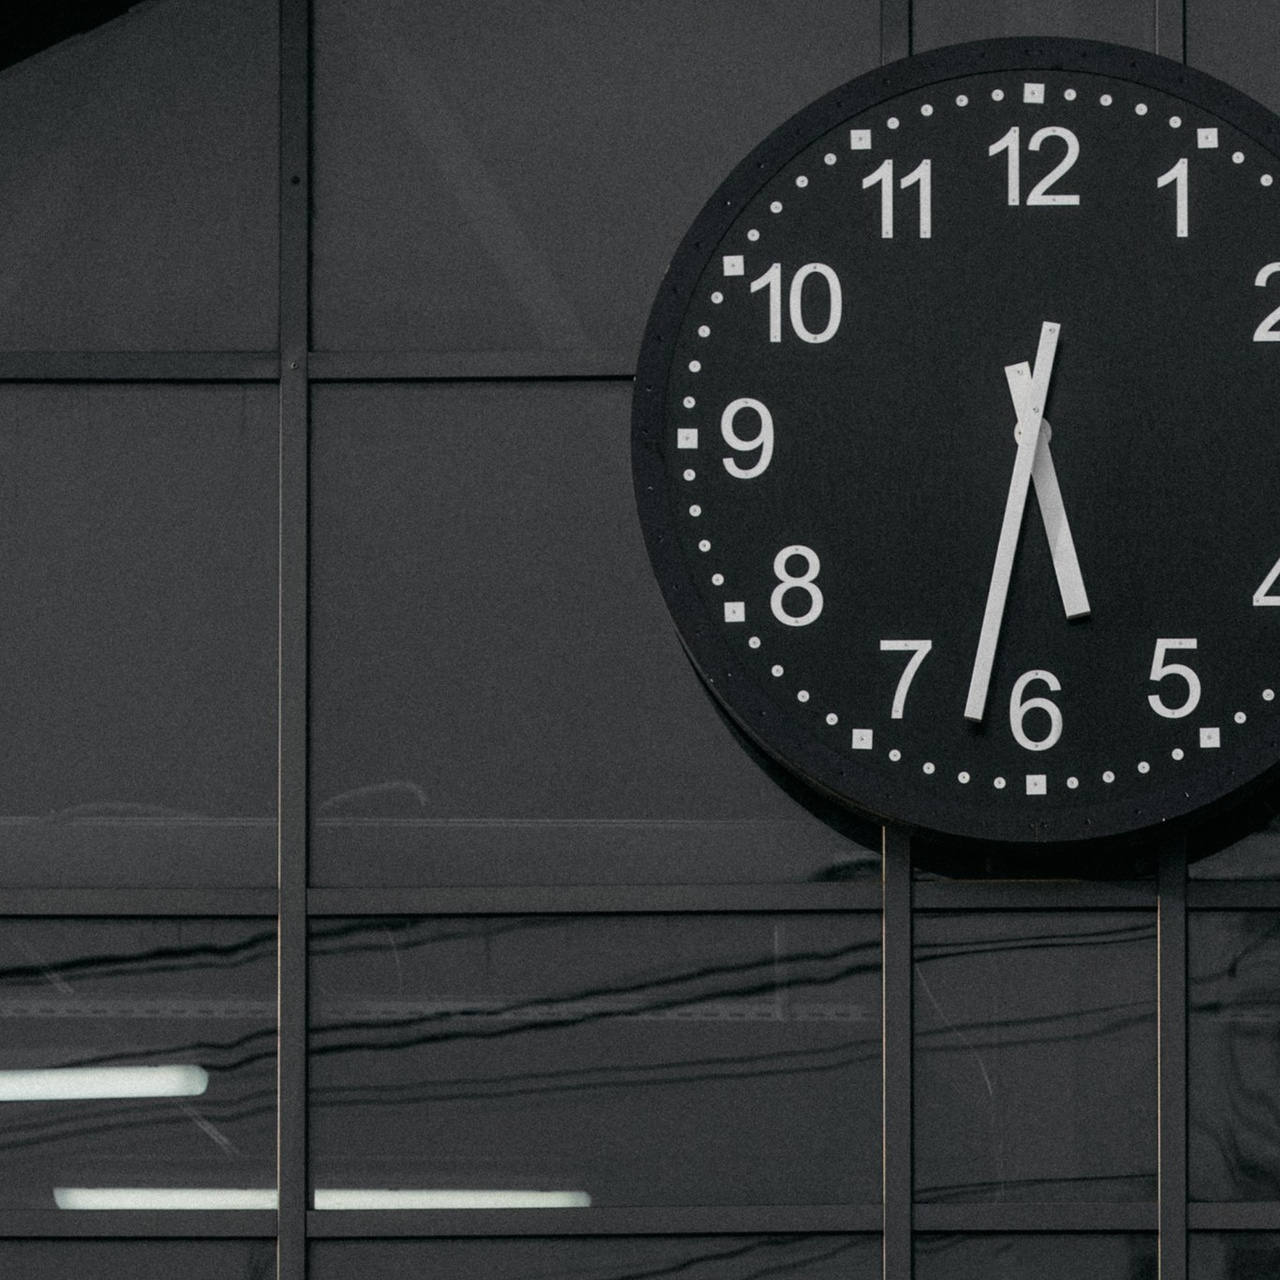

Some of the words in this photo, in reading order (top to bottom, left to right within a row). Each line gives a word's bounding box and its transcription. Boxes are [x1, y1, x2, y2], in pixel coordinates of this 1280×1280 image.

[862, 159, 931, 238] 11
[989, 127, 1080, 206] 12
[1157, 158, 1188, 237] 1
[750, 263, 842, 343] 10
[721, 398, 774, 479] 9
[770, 545, 823, 626] 8
[880, 640, 932, 718] 7
[1009, 670, 1062, 751] 6
[1148, 639, 1201, 718] 5
